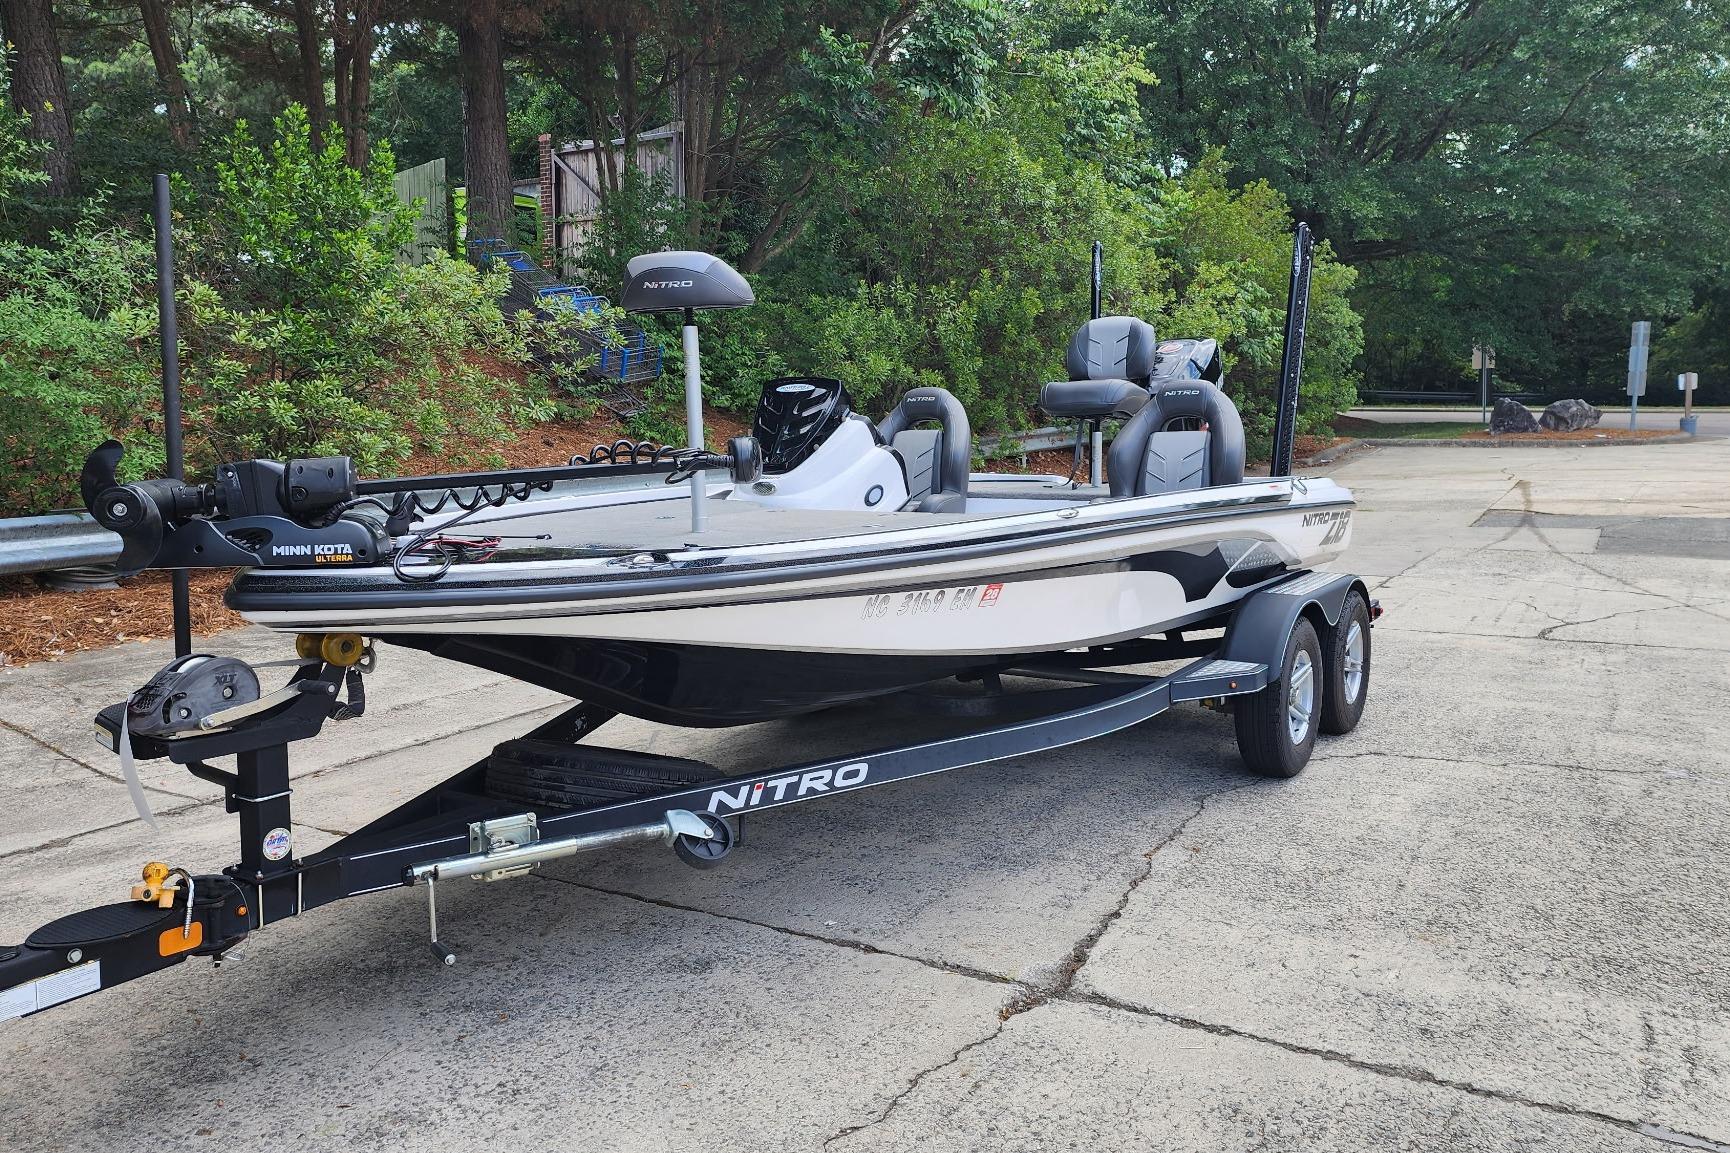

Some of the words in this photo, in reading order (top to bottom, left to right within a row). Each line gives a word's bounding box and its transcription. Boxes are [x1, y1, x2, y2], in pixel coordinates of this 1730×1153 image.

[273, 544, 311, 556] MINN
[314, 543, 353, 555] KOTA
[315, 554, 353, 563] ULTERRA
[861, 594, 891, 621] NC
[707, 762, 869, 814] NITRO
